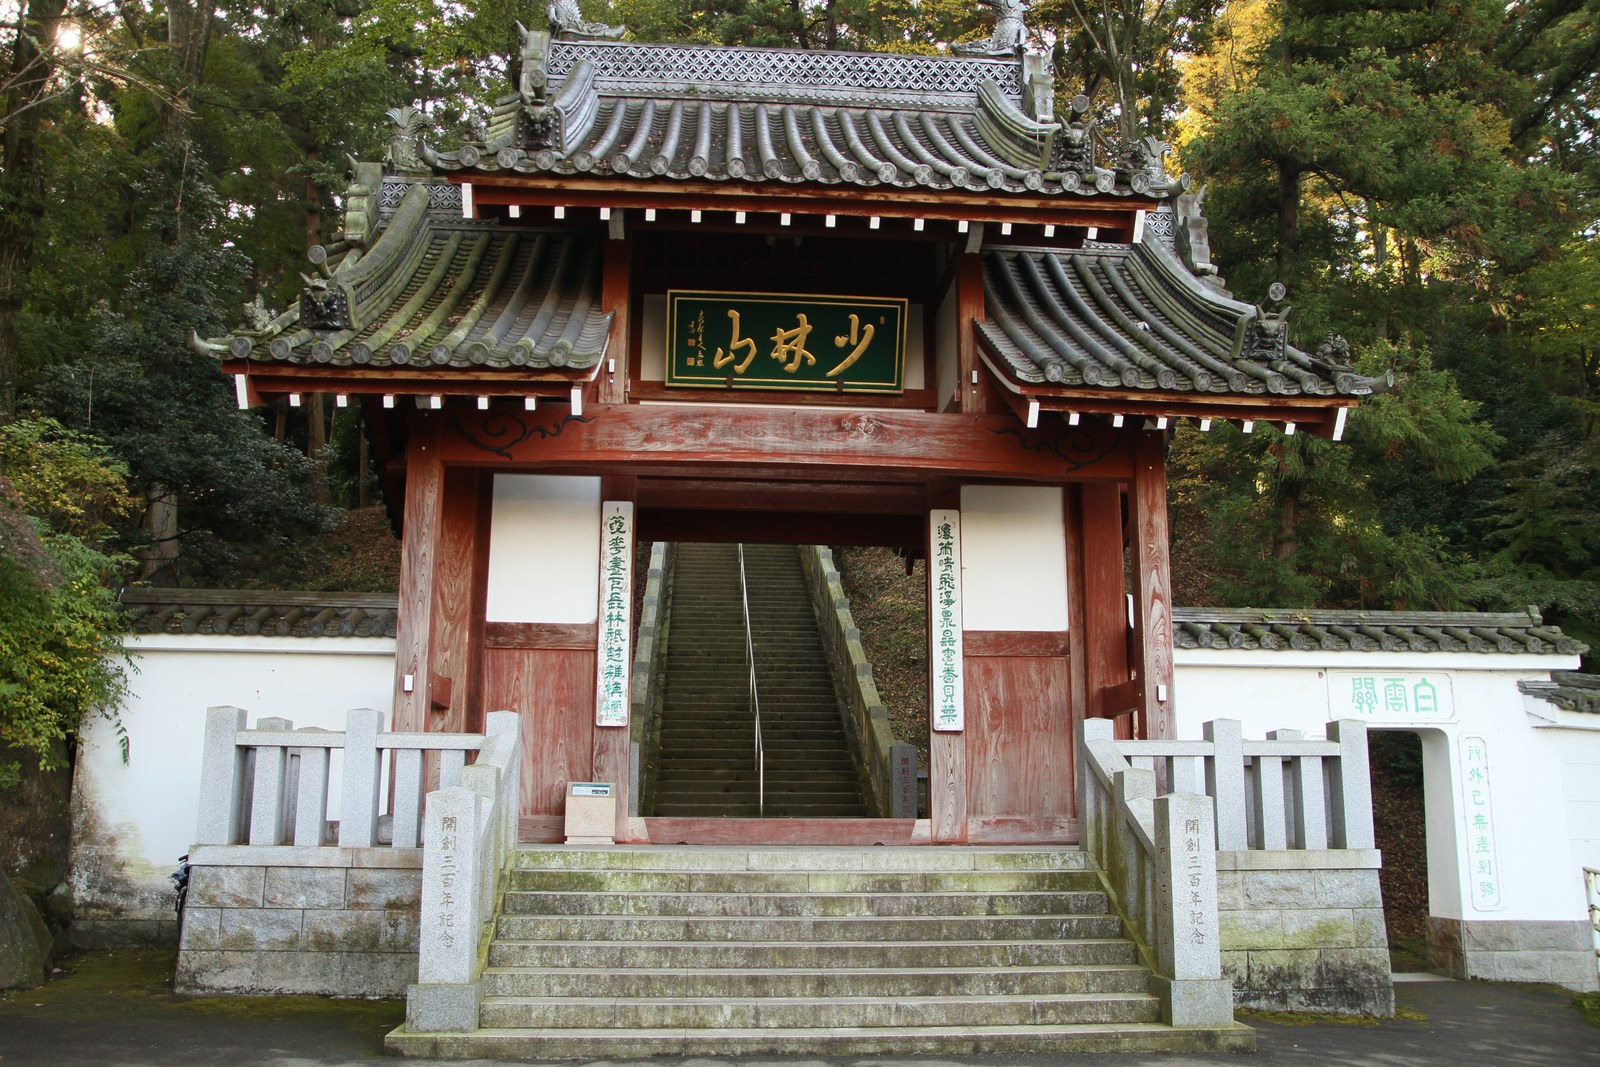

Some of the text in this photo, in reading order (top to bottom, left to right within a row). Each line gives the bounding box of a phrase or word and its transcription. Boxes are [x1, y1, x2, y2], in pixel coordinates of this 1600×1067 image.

[713, 308, 875, 378] 少林山
[437, 816, 458, 949] 開創三百年記念
[1185, 819, 1206, 945] 開創三百年記念
